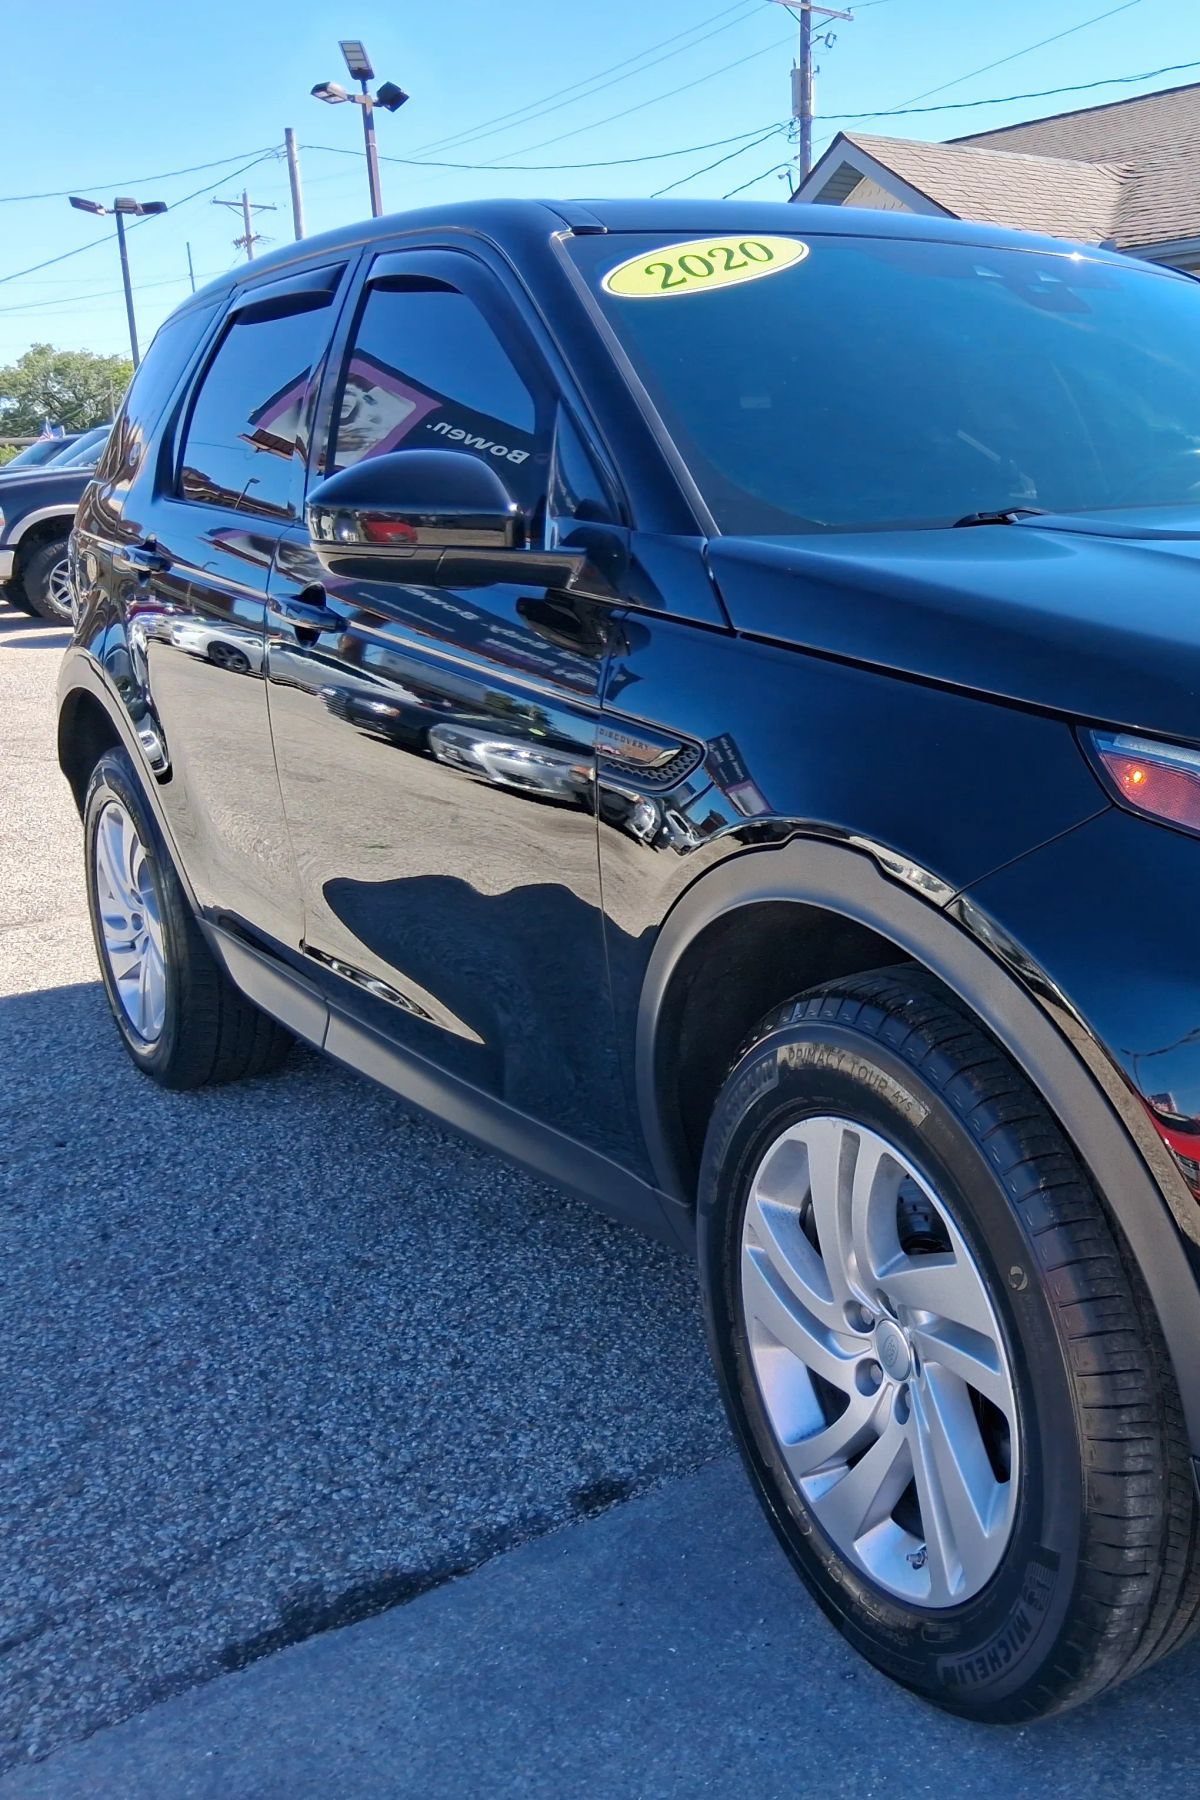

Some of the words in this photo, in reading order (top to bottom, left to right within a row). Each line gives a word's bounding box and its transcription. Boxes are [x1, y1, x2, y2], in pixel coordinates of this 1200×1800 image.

[644, 241, 774, 290] 2020
[599, 728, 649, 751] DISCOVERY
[788, 1047, 844, 1071] PRIMACY
[850, 1058, 889, 1090] TOUR
